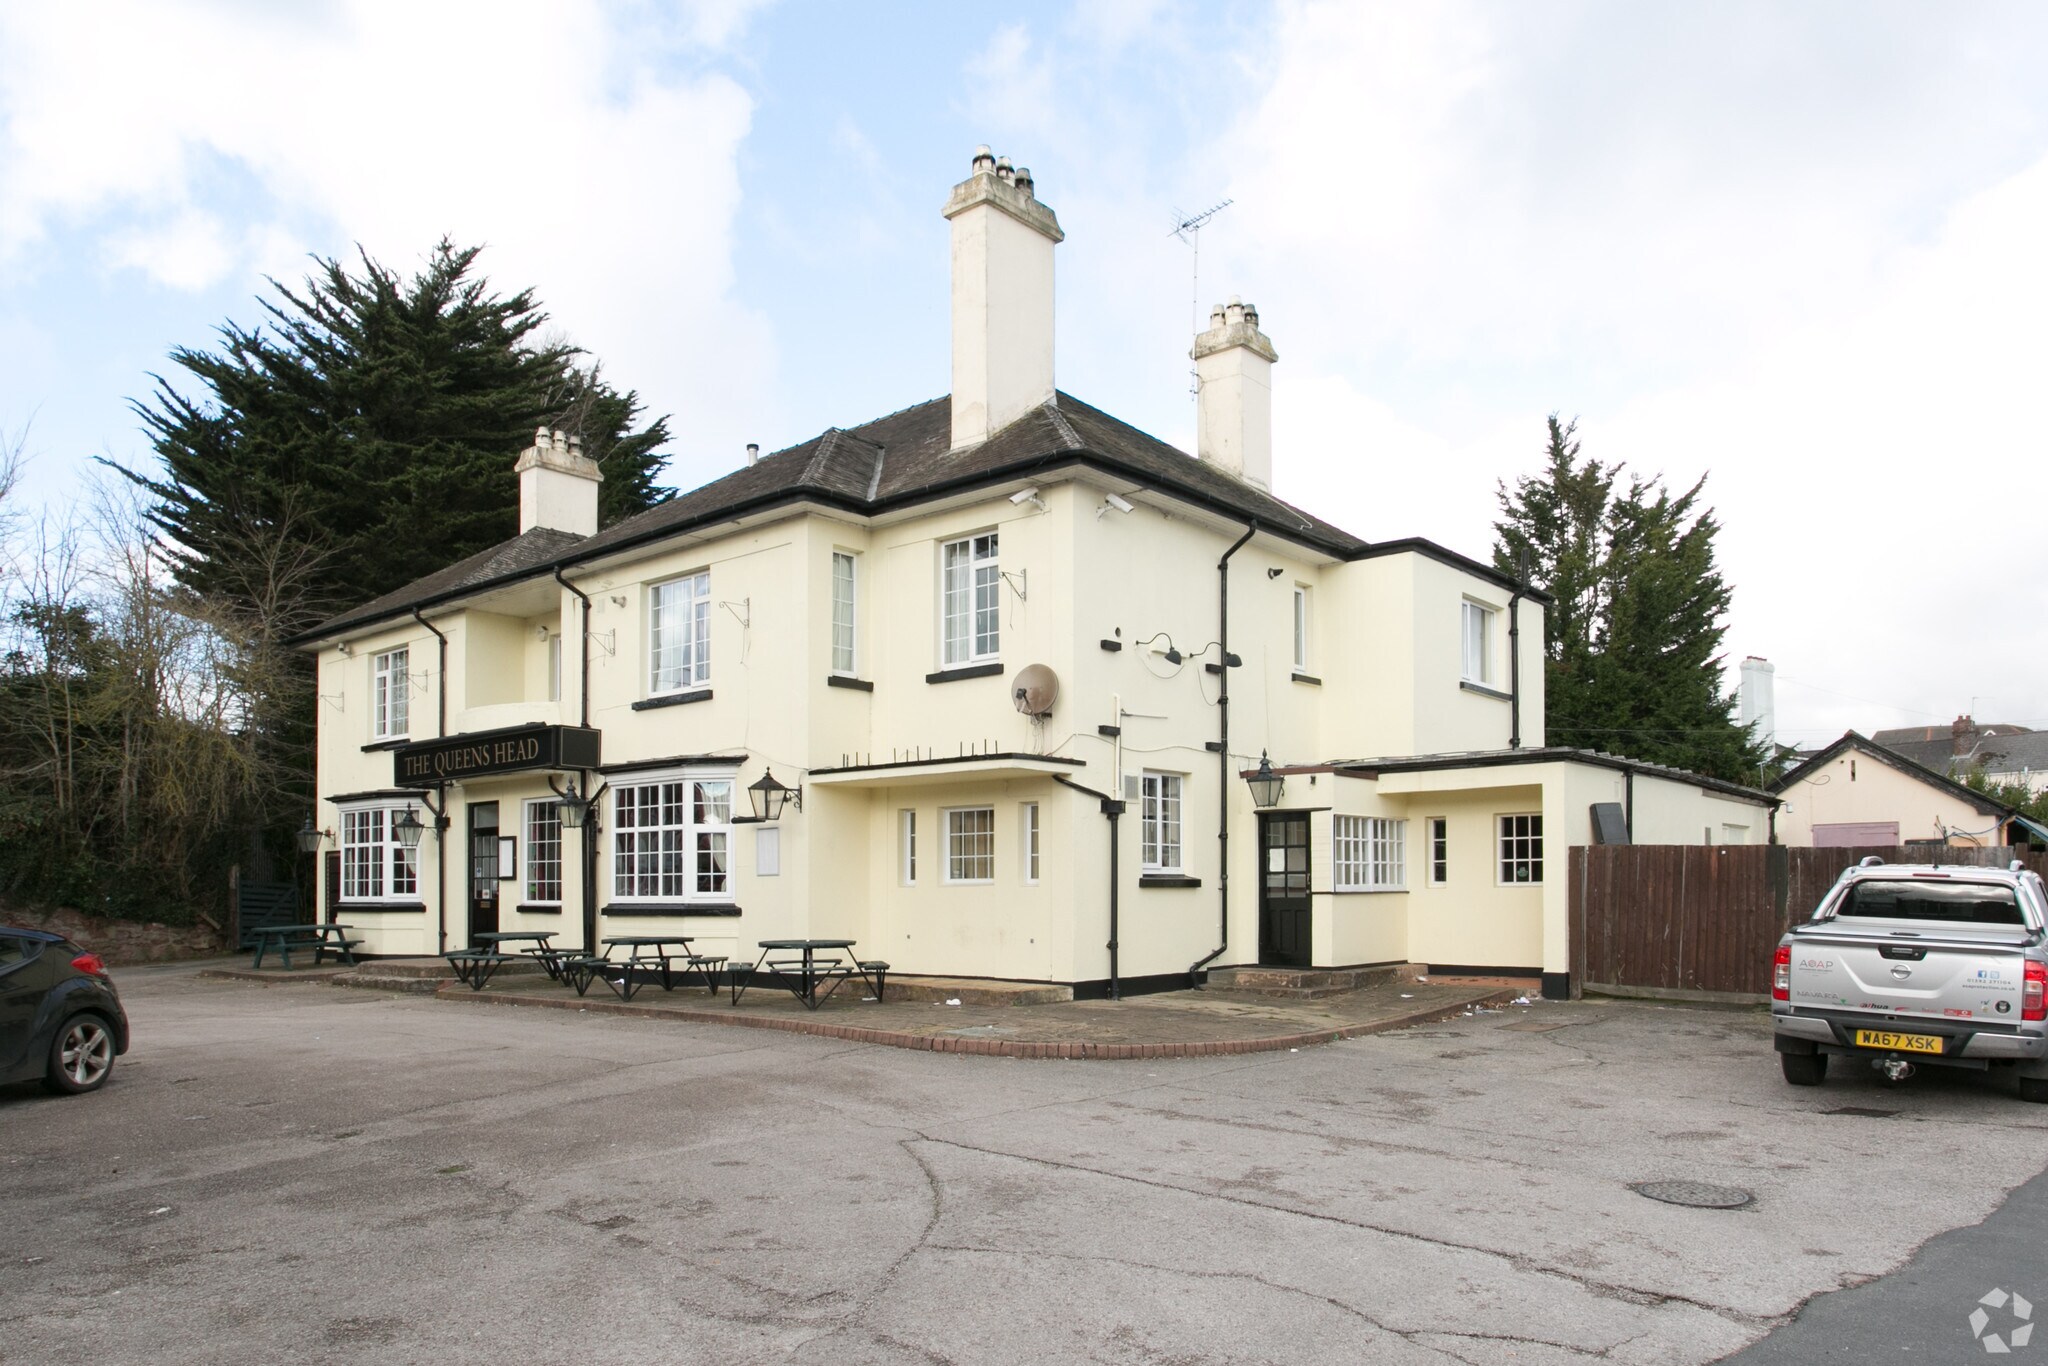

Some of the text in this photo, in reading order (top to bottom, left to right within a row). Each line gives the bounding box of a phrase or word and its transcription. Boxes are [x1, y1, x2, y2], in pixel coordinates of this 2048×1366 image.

[405, 738, 539, 777] THE QUEENS HEAD
[1862, 1031, 1935, 1050] WA67 XSK
